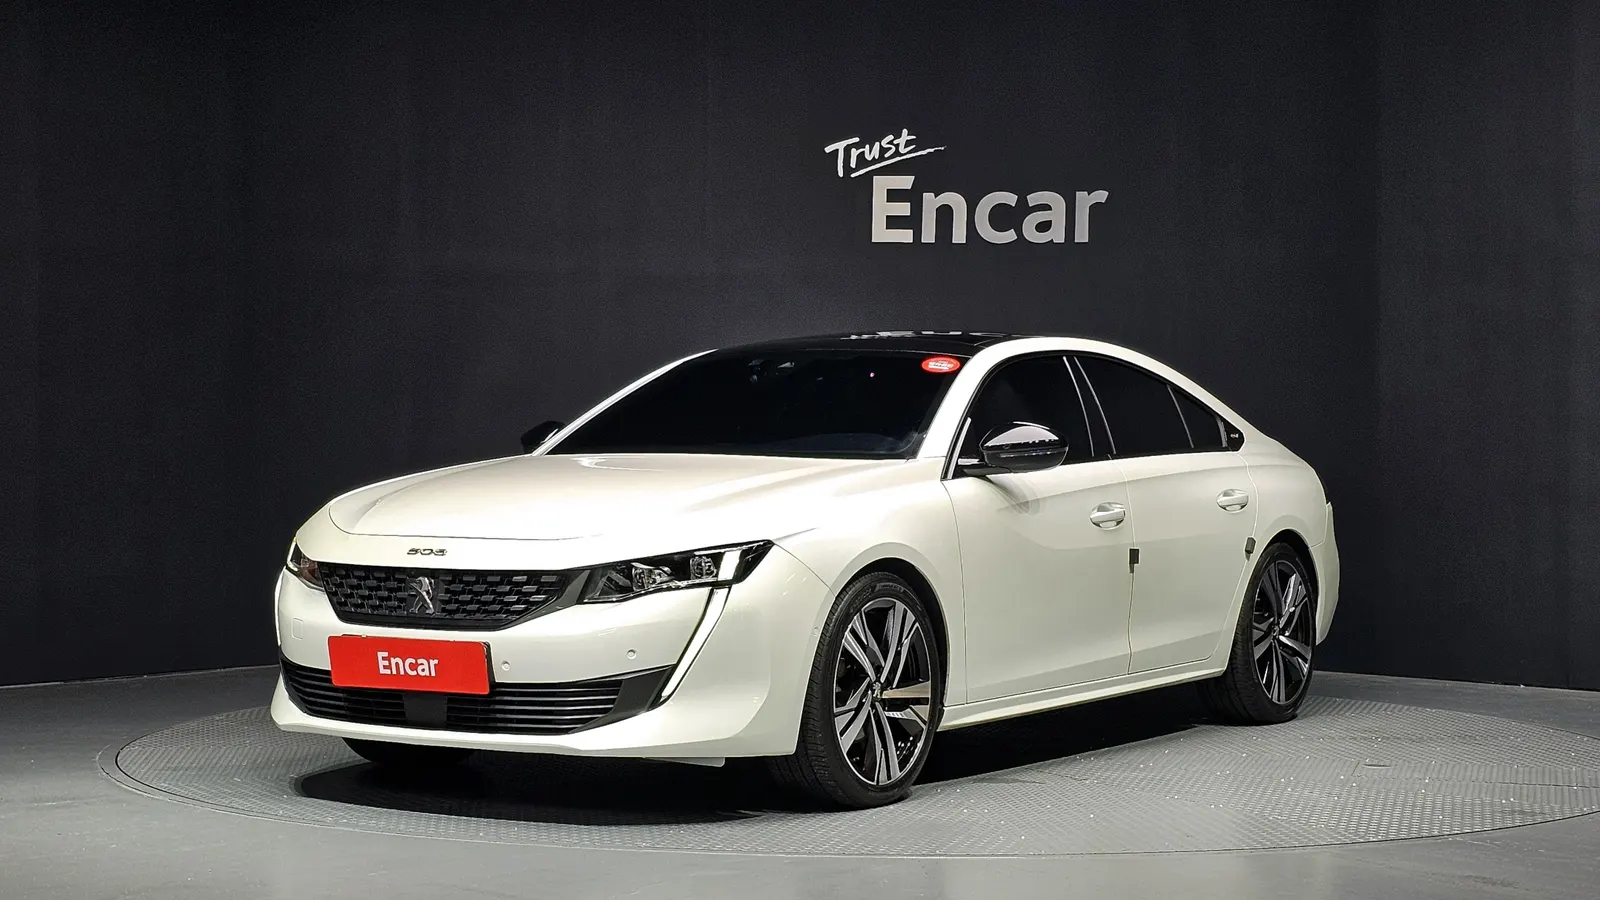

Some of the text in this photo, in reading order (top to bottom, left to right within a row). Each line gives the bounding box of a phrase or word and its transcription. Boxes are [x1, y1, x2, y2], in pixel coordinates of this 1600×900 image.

[824, 128, 917, 177] Trust
[871, 175, 1109, 244] Encar
[377, 651, 438, 677] Encar
